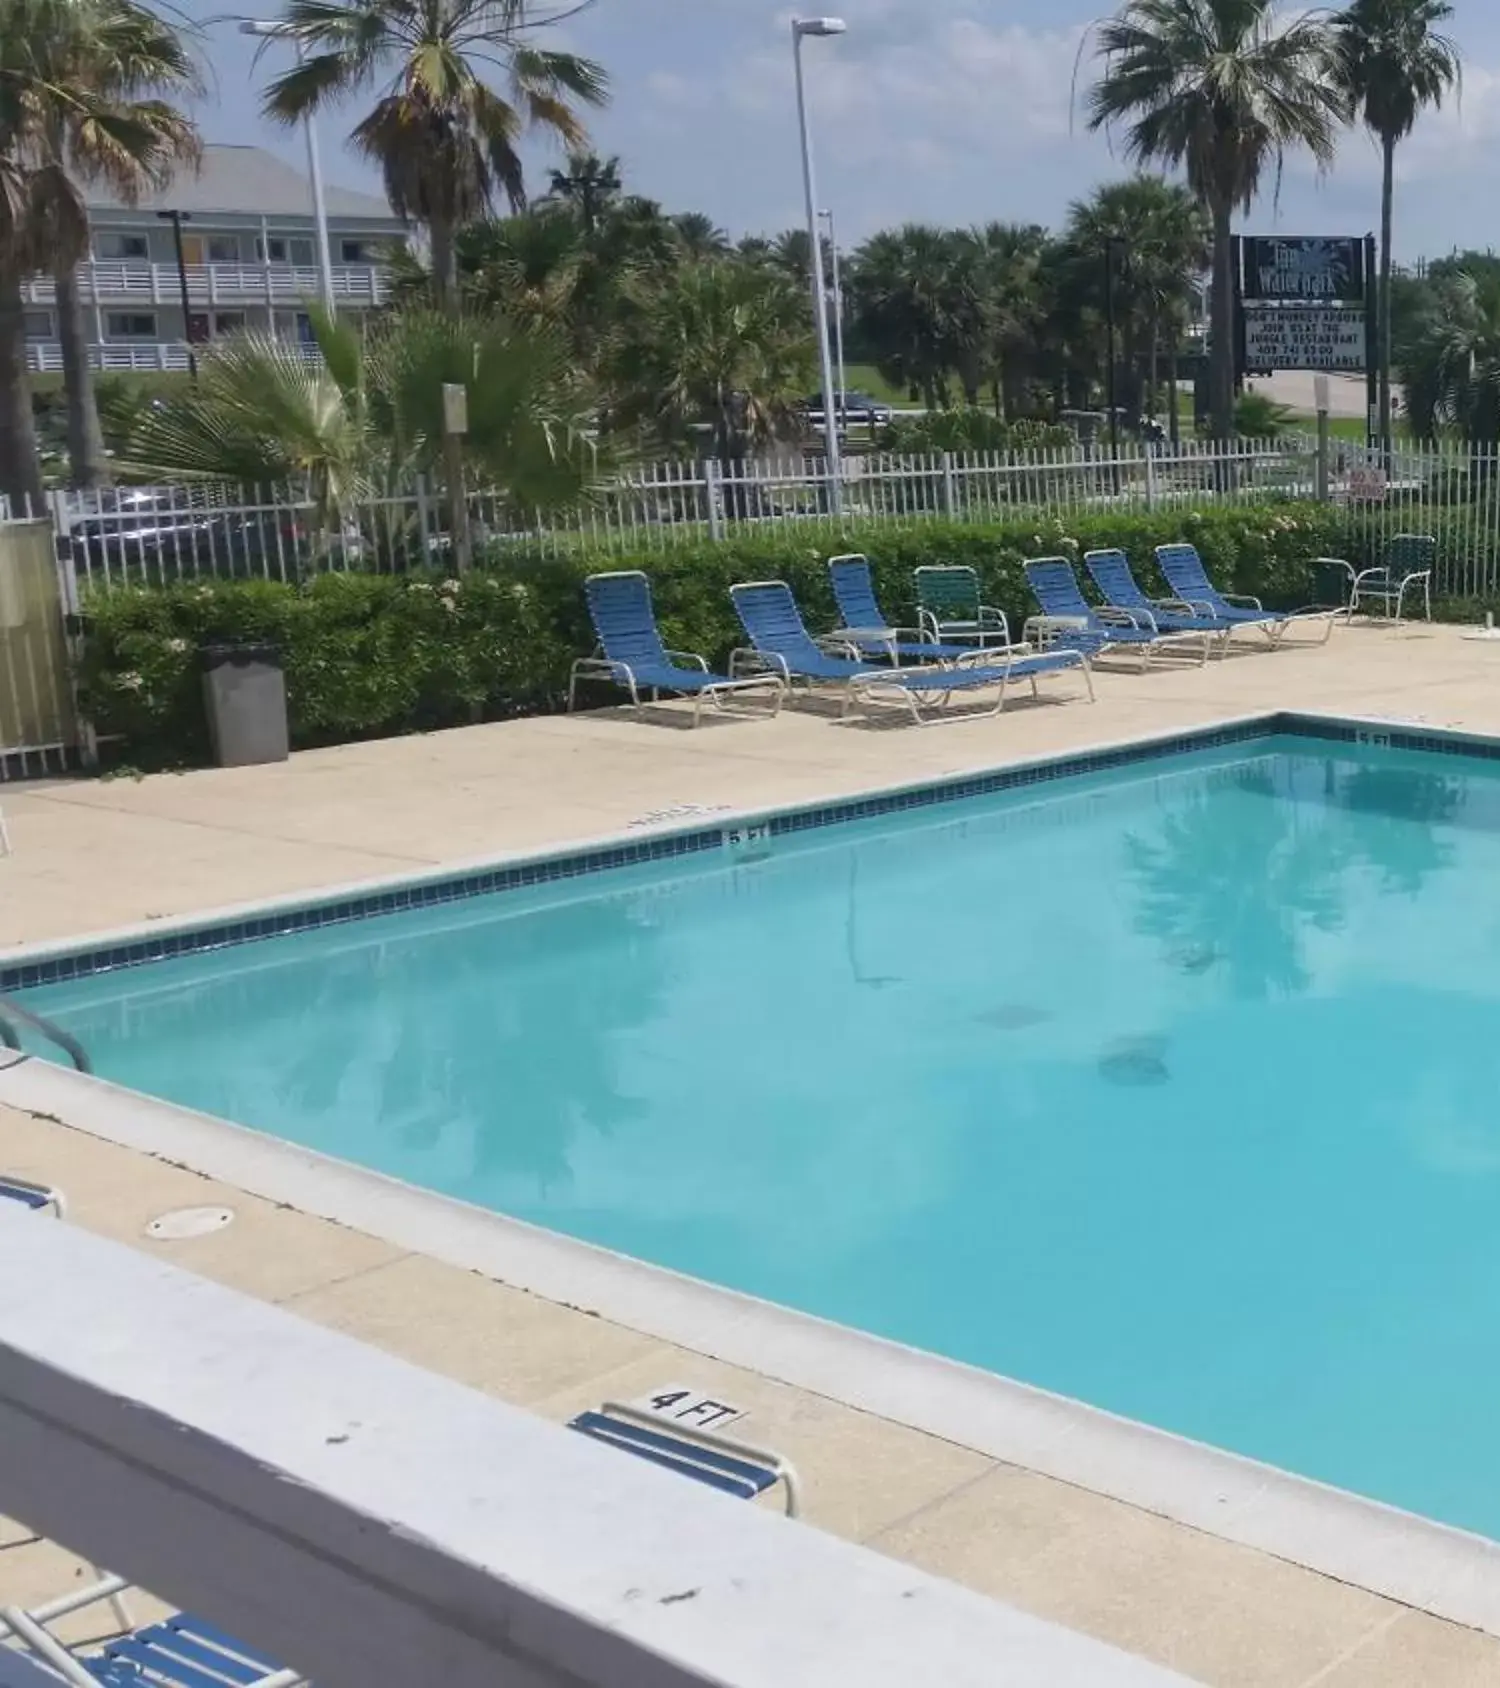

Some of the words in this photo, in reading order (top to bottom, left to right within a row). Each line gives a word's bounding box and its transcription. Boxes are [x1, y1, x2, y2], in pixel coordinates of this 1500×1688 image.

[1249, 333, 1288, 344] JUNGLE
[1292, 333, 1358, 344] RESTAURANT
[1247, 355, 1299, 365] DELIVERY
[1305, 356, 1360, 366] AVAILABLE
[650, 1391, 691, 1410] 4
[675, 1399, 738, 1427] FT
